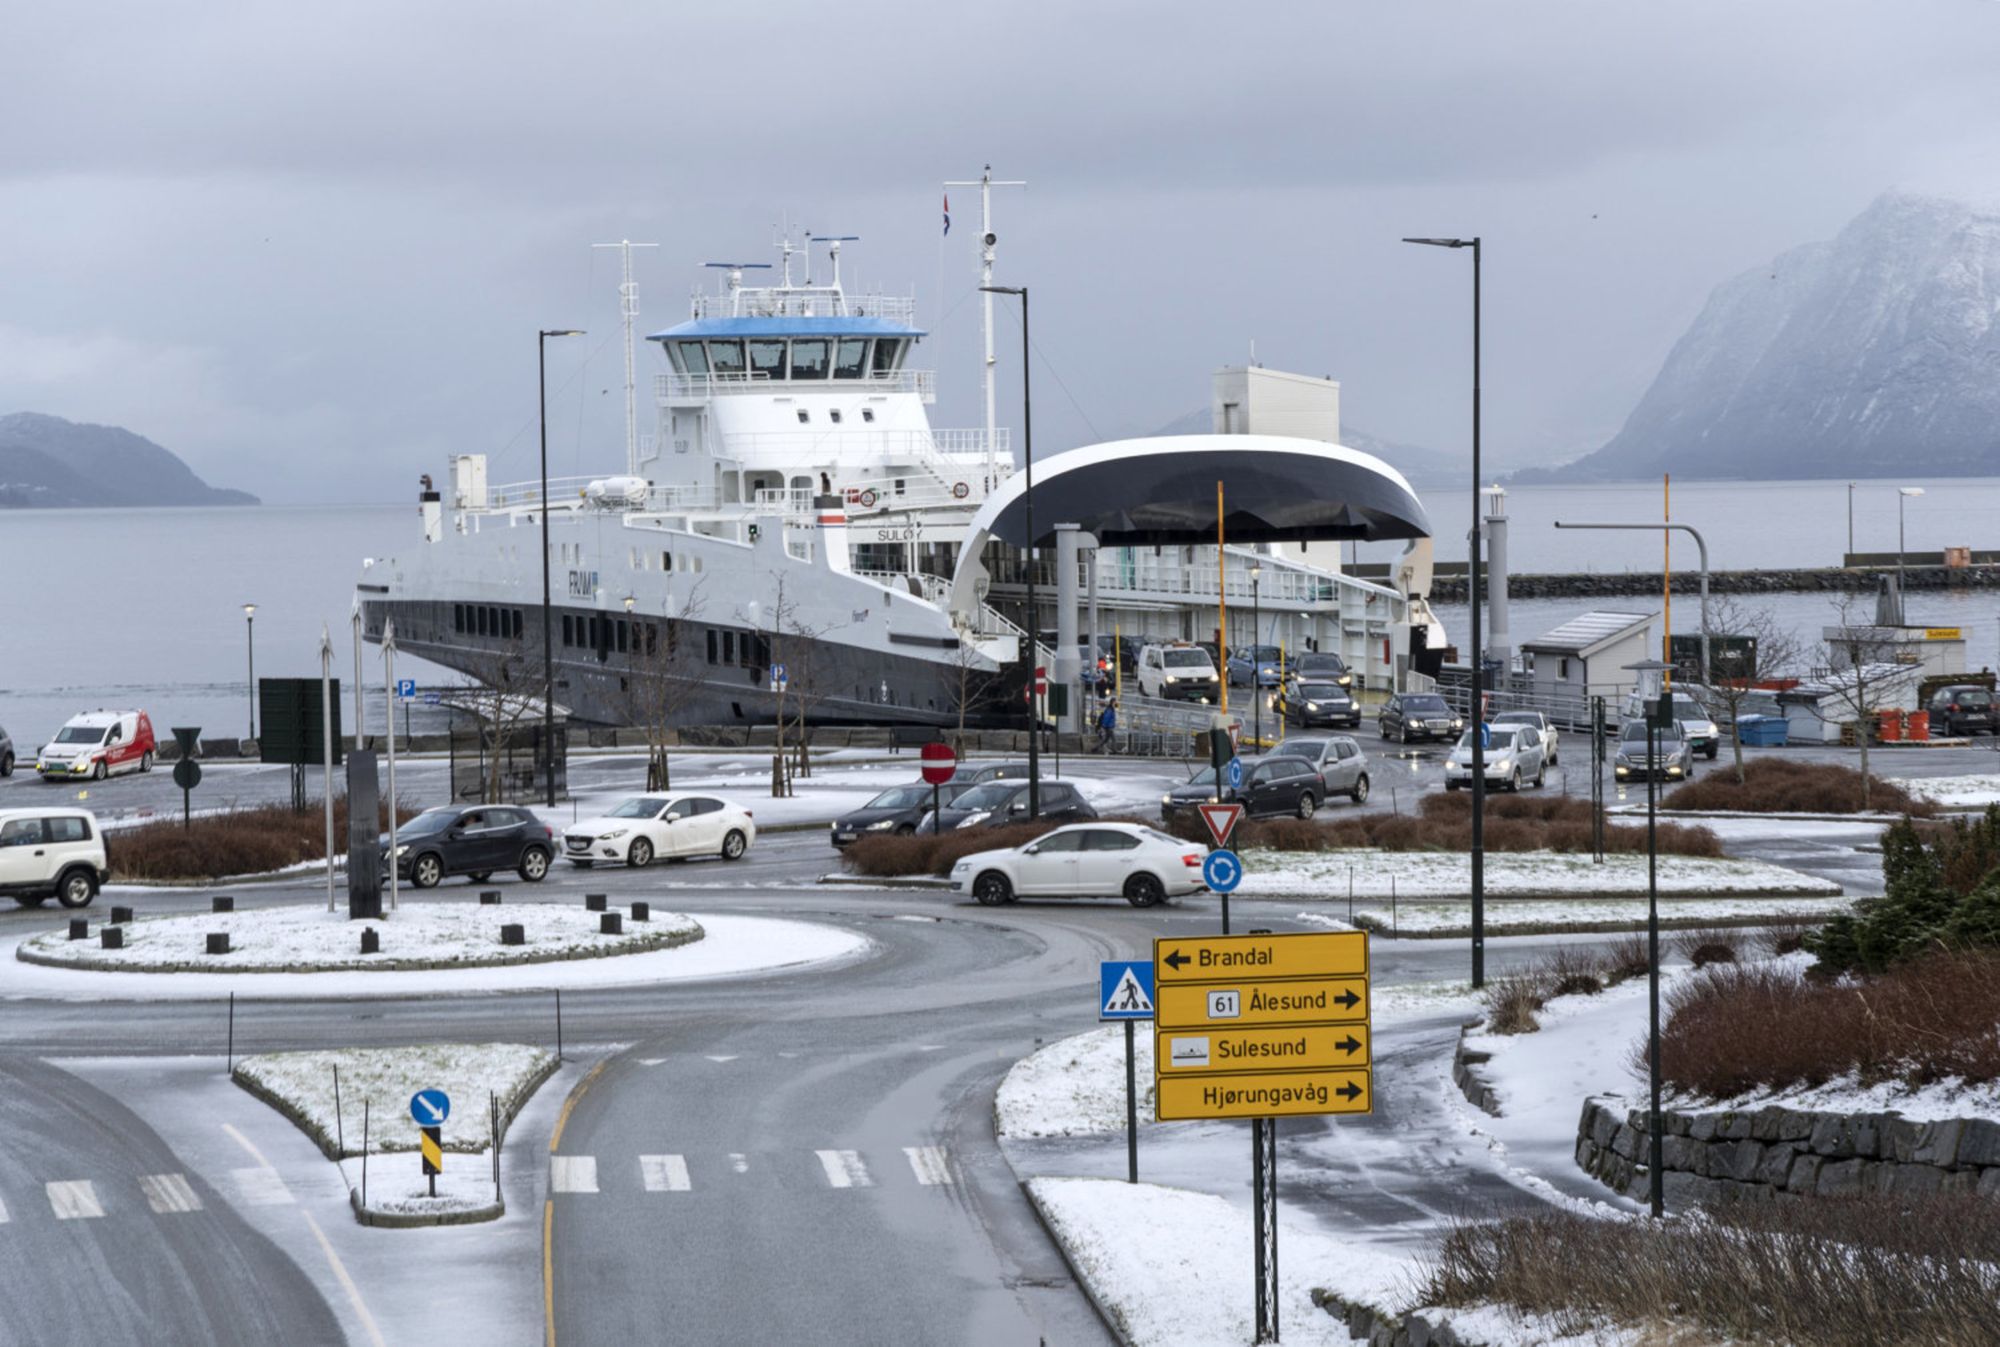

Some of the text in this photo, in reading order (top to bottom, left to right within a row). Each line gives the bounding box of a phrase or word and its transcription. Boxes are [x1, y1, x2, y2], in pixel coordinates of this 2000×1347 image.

[402, 681, 412, 695] P
[1199, 946, 1273, 967] Brandal
[1214, 988, 1326, 1013] 61 Ålesund
[1218, 1037, 1306, 1059] Sulesund
[1203, 1083, 1328, 1109] Hjørungavåg
